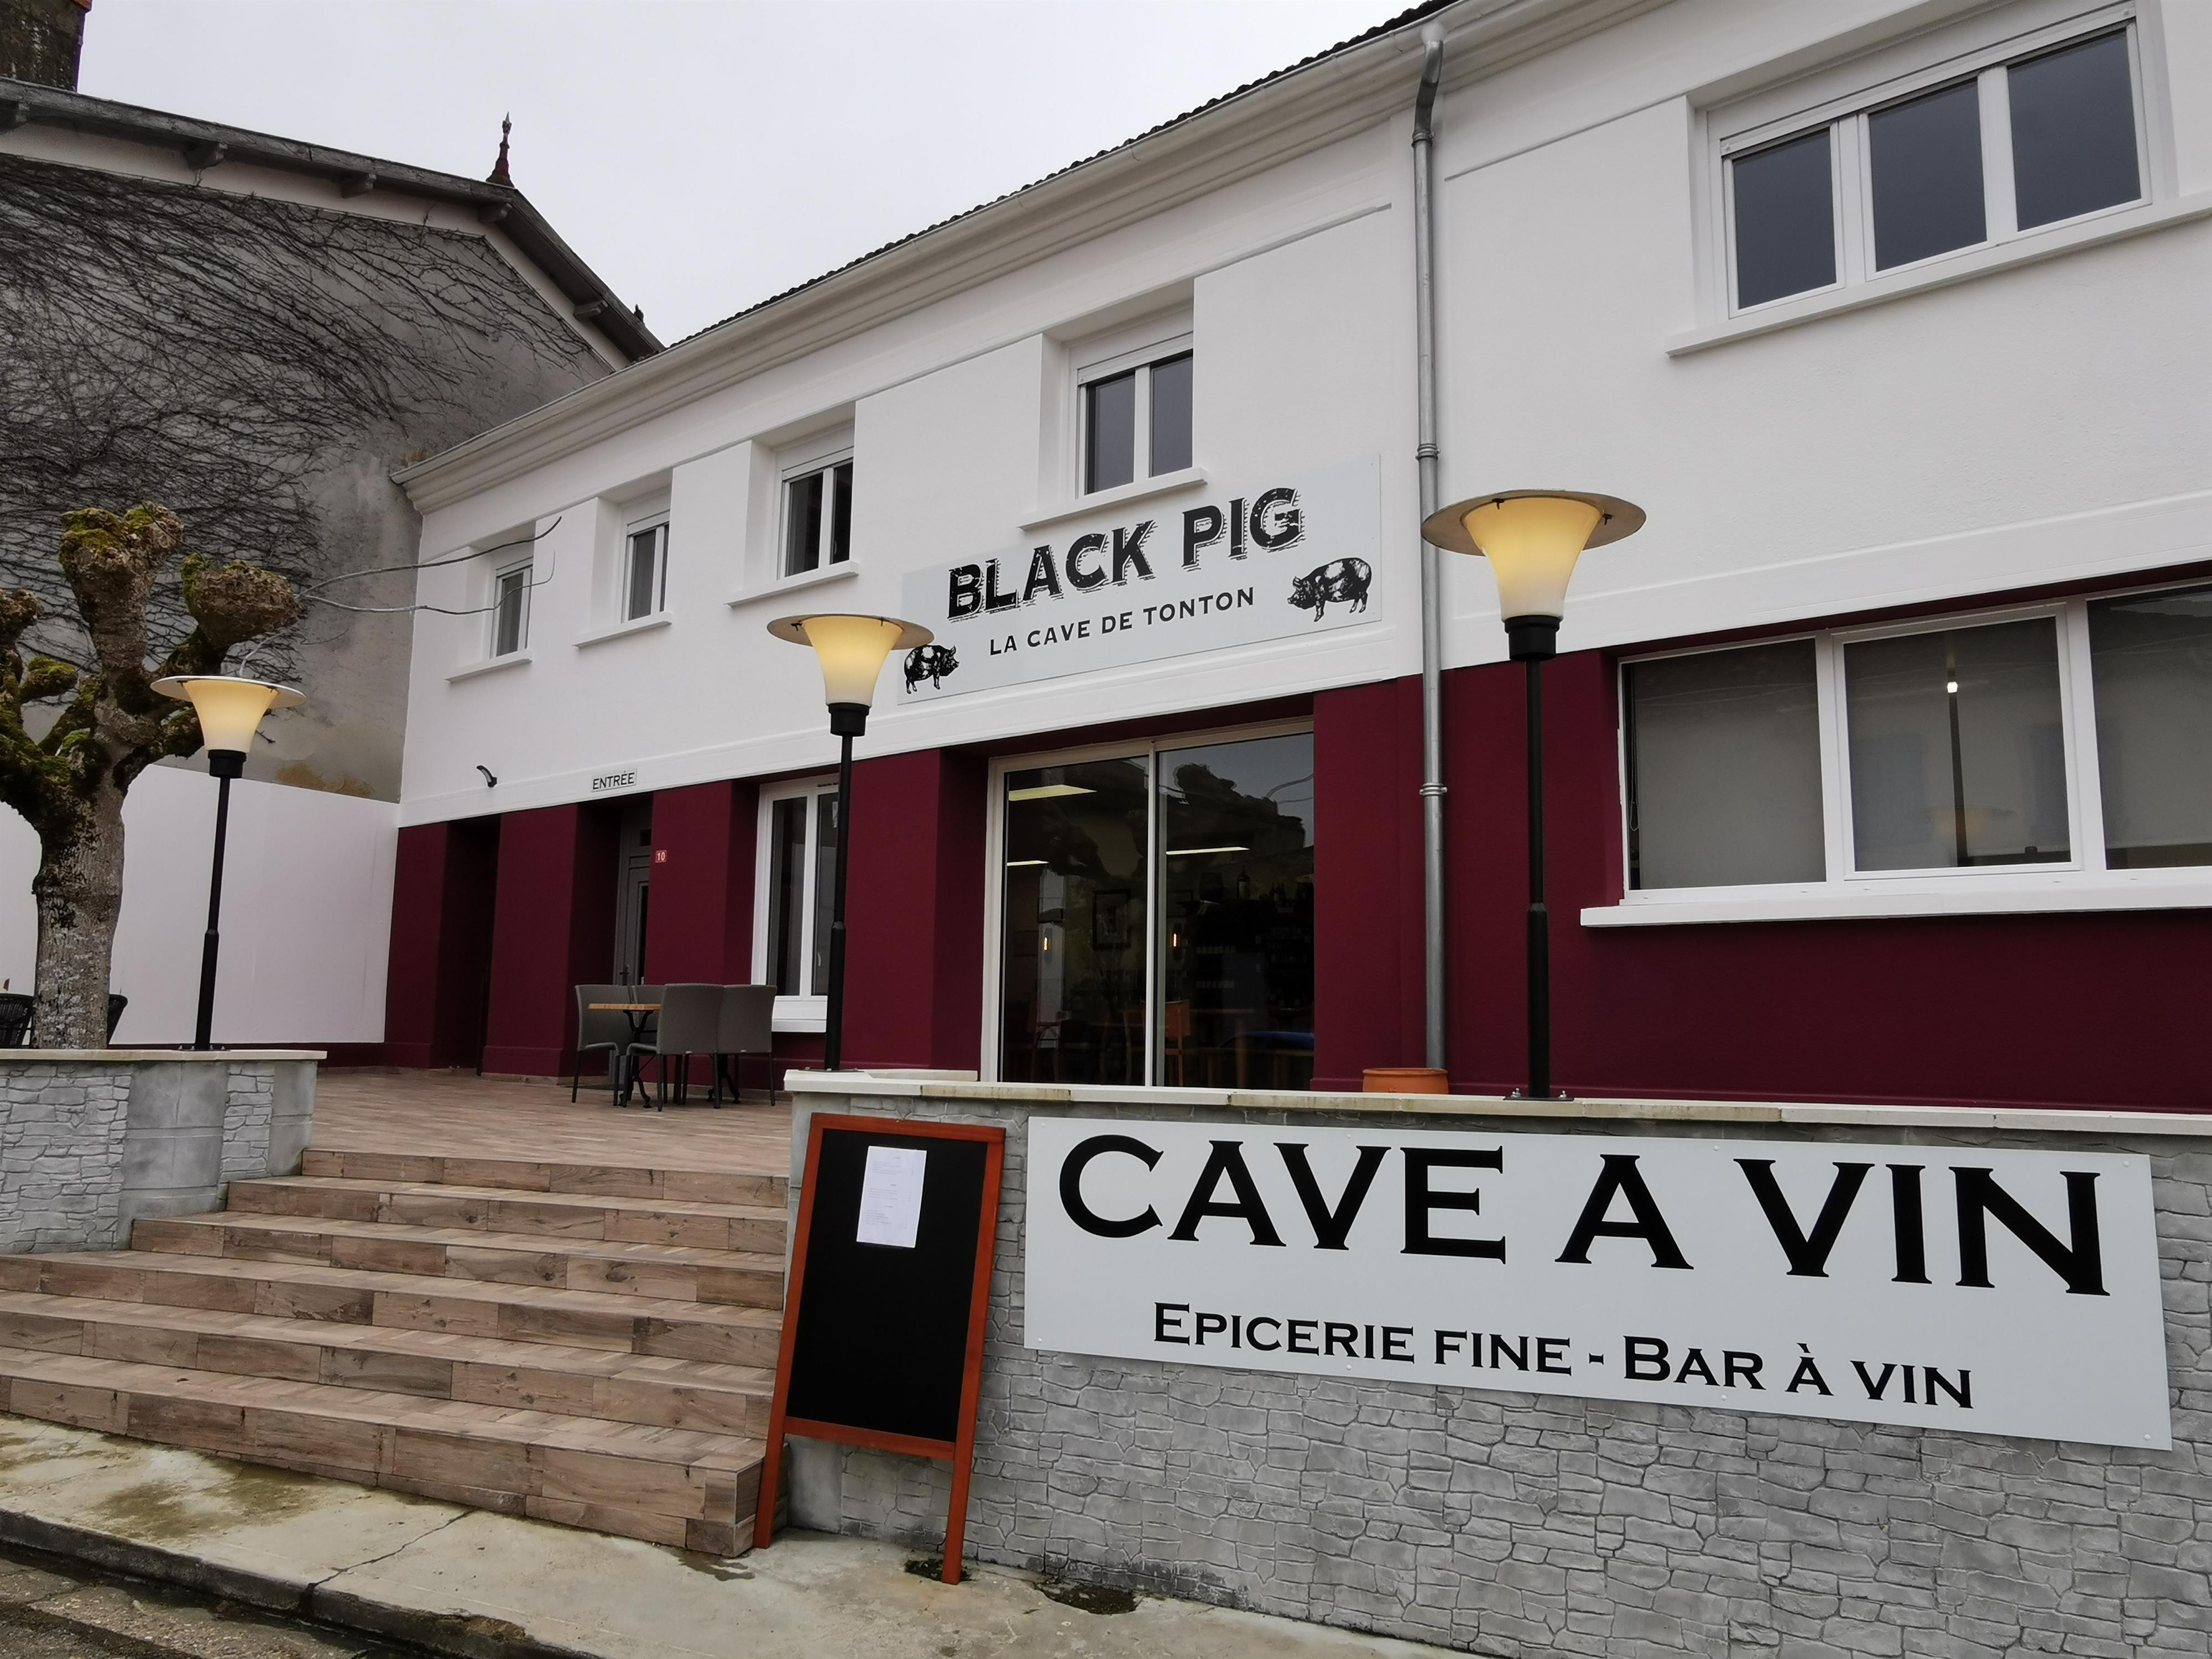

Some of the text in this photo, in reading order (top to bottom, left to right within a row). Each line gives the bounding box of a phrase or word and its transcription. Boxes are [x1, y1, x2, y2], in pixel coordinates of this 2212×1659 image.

[947, 488, 1307, 622] BLACK PIG
[990, 587, 1254, 655] LA CAVE DE TONTON
[592, 770, 635, 790] ENTRÉE
[656, 852, 665, 861] 10
[1059, 1134, 2110, 1296] CAVE A VIN
[1589, 1353, 1604, 1365] -
